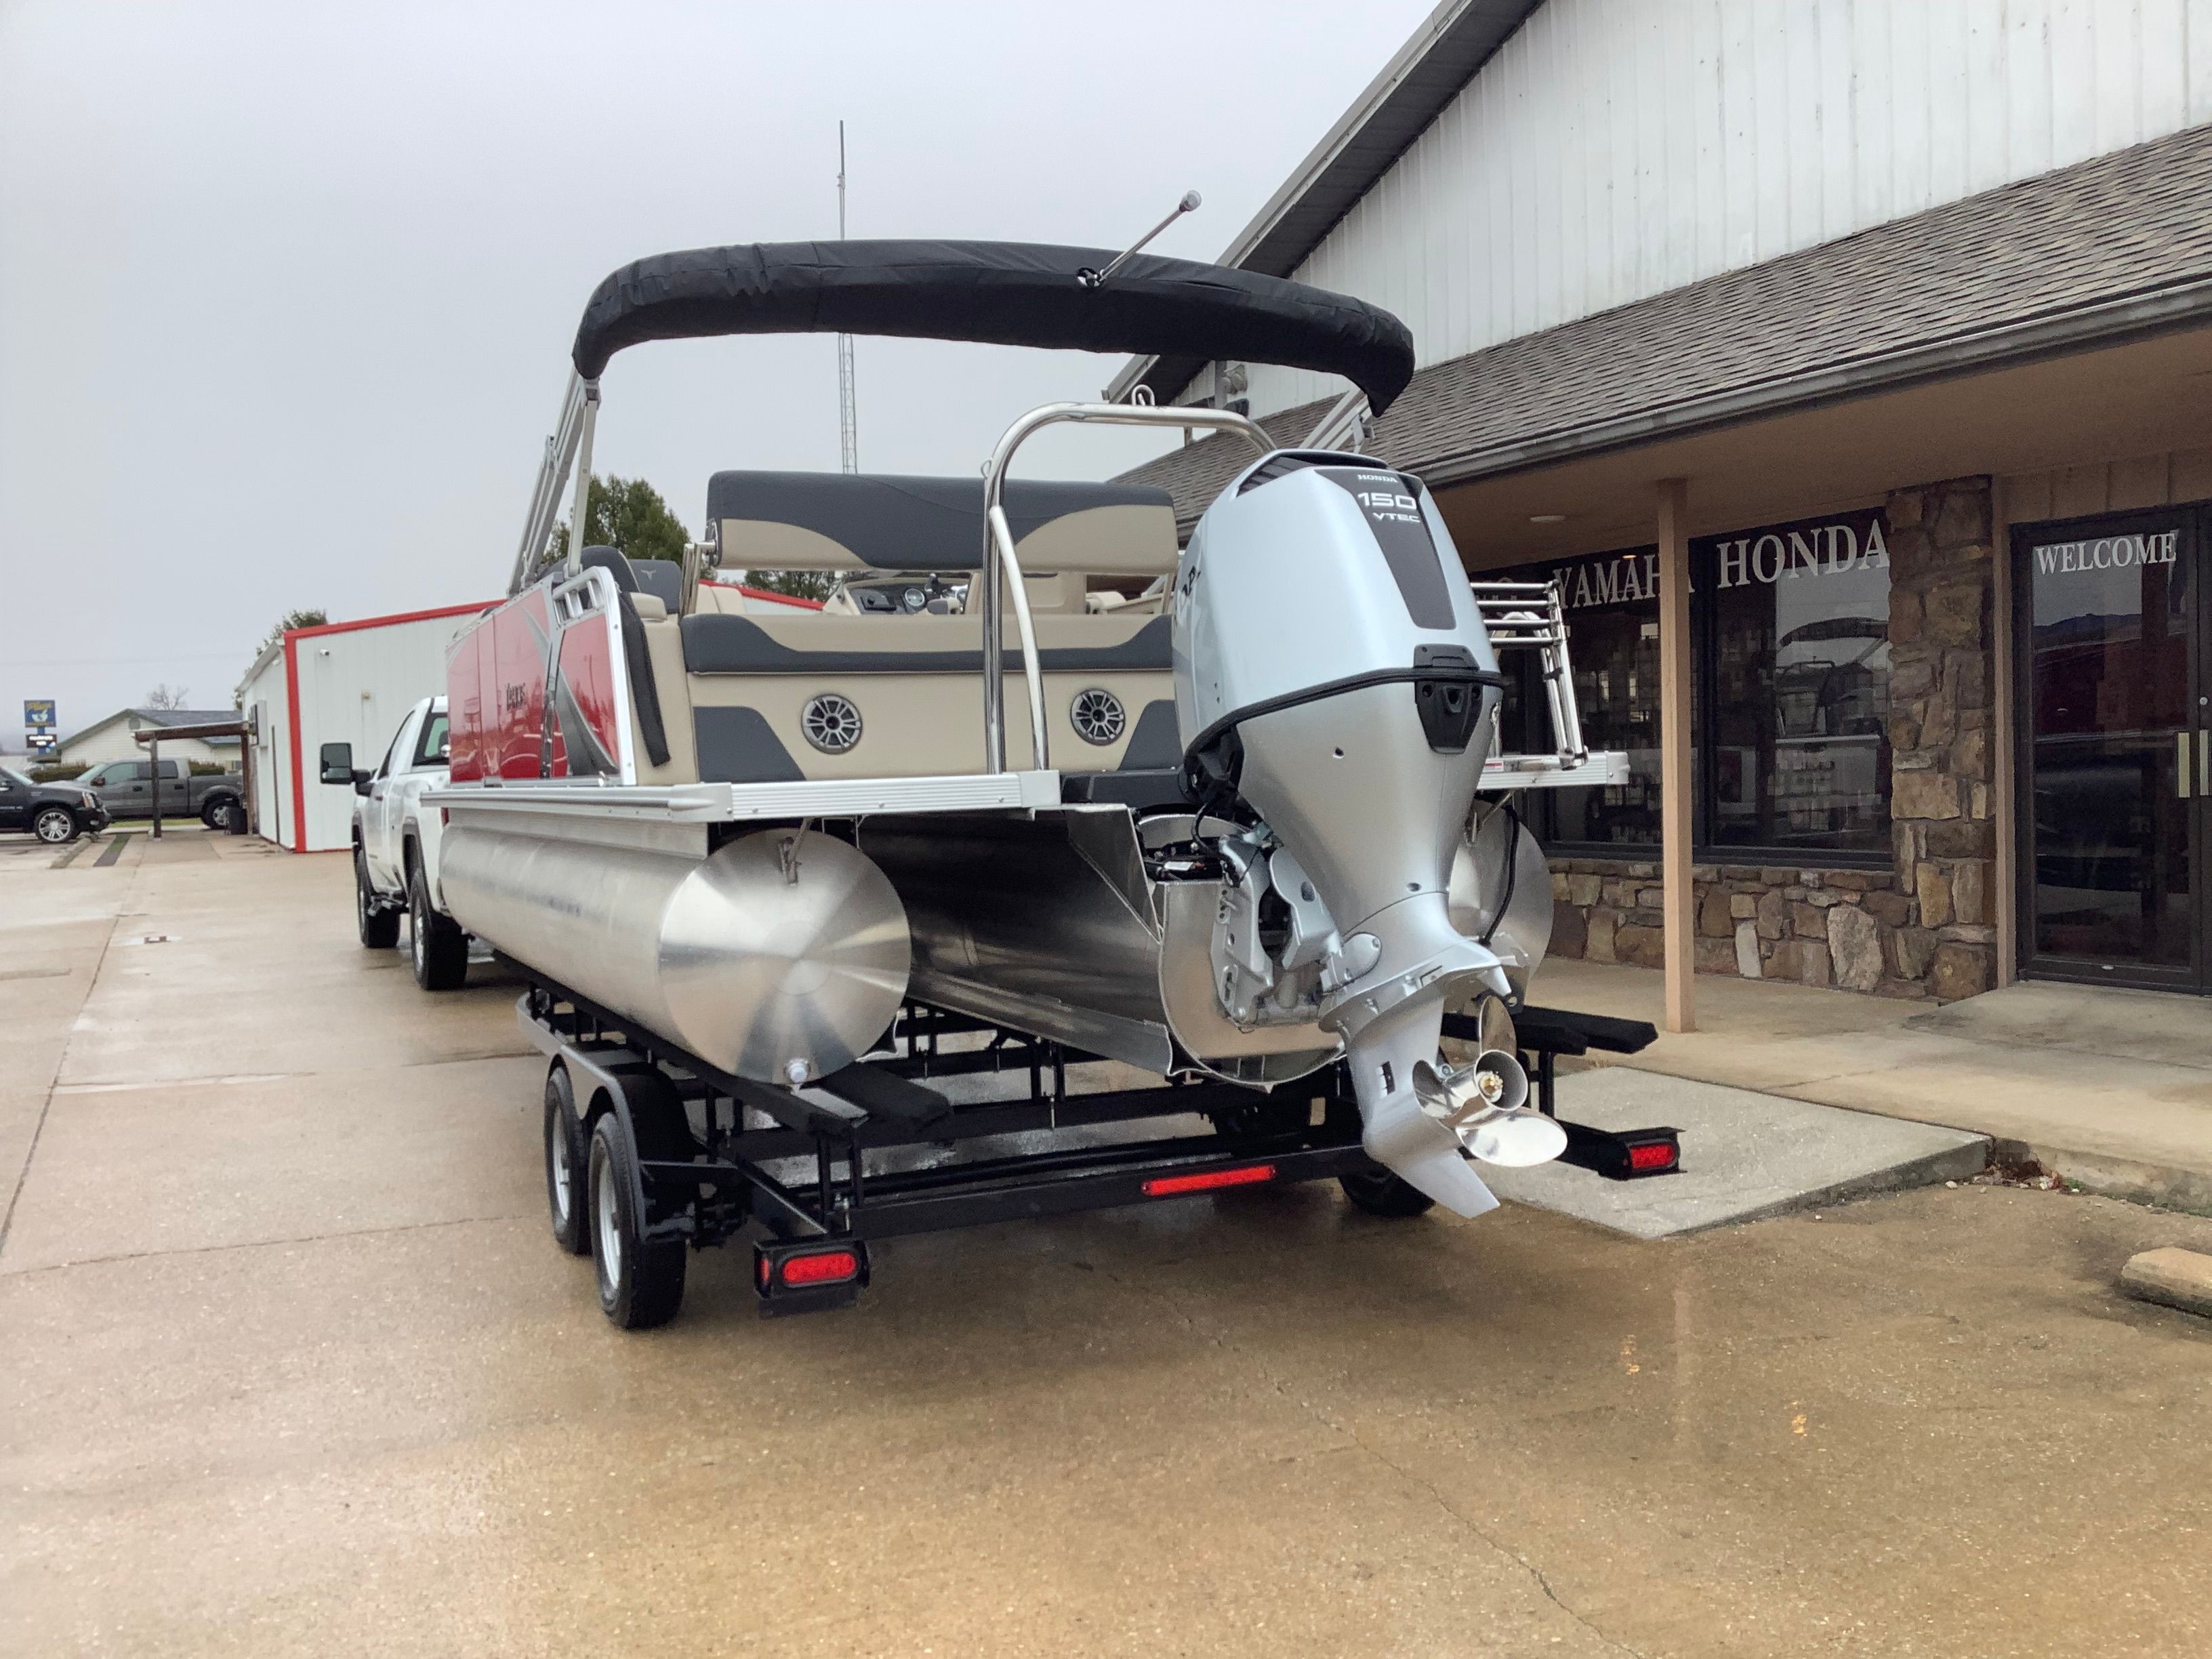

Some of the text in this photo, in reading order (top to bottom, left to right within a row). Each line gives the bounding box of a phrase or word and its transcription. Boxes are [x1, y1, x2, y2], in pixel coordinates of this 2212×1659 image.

[1357, 474, 1398, 483] HONDA
[1357, 492, 1417, 510] 150
[1372, 512, 1420, 523] VTEC
[1717, 518, 1890, 589] HONDA
[2035, 533, 2177, 575] WELCOME
